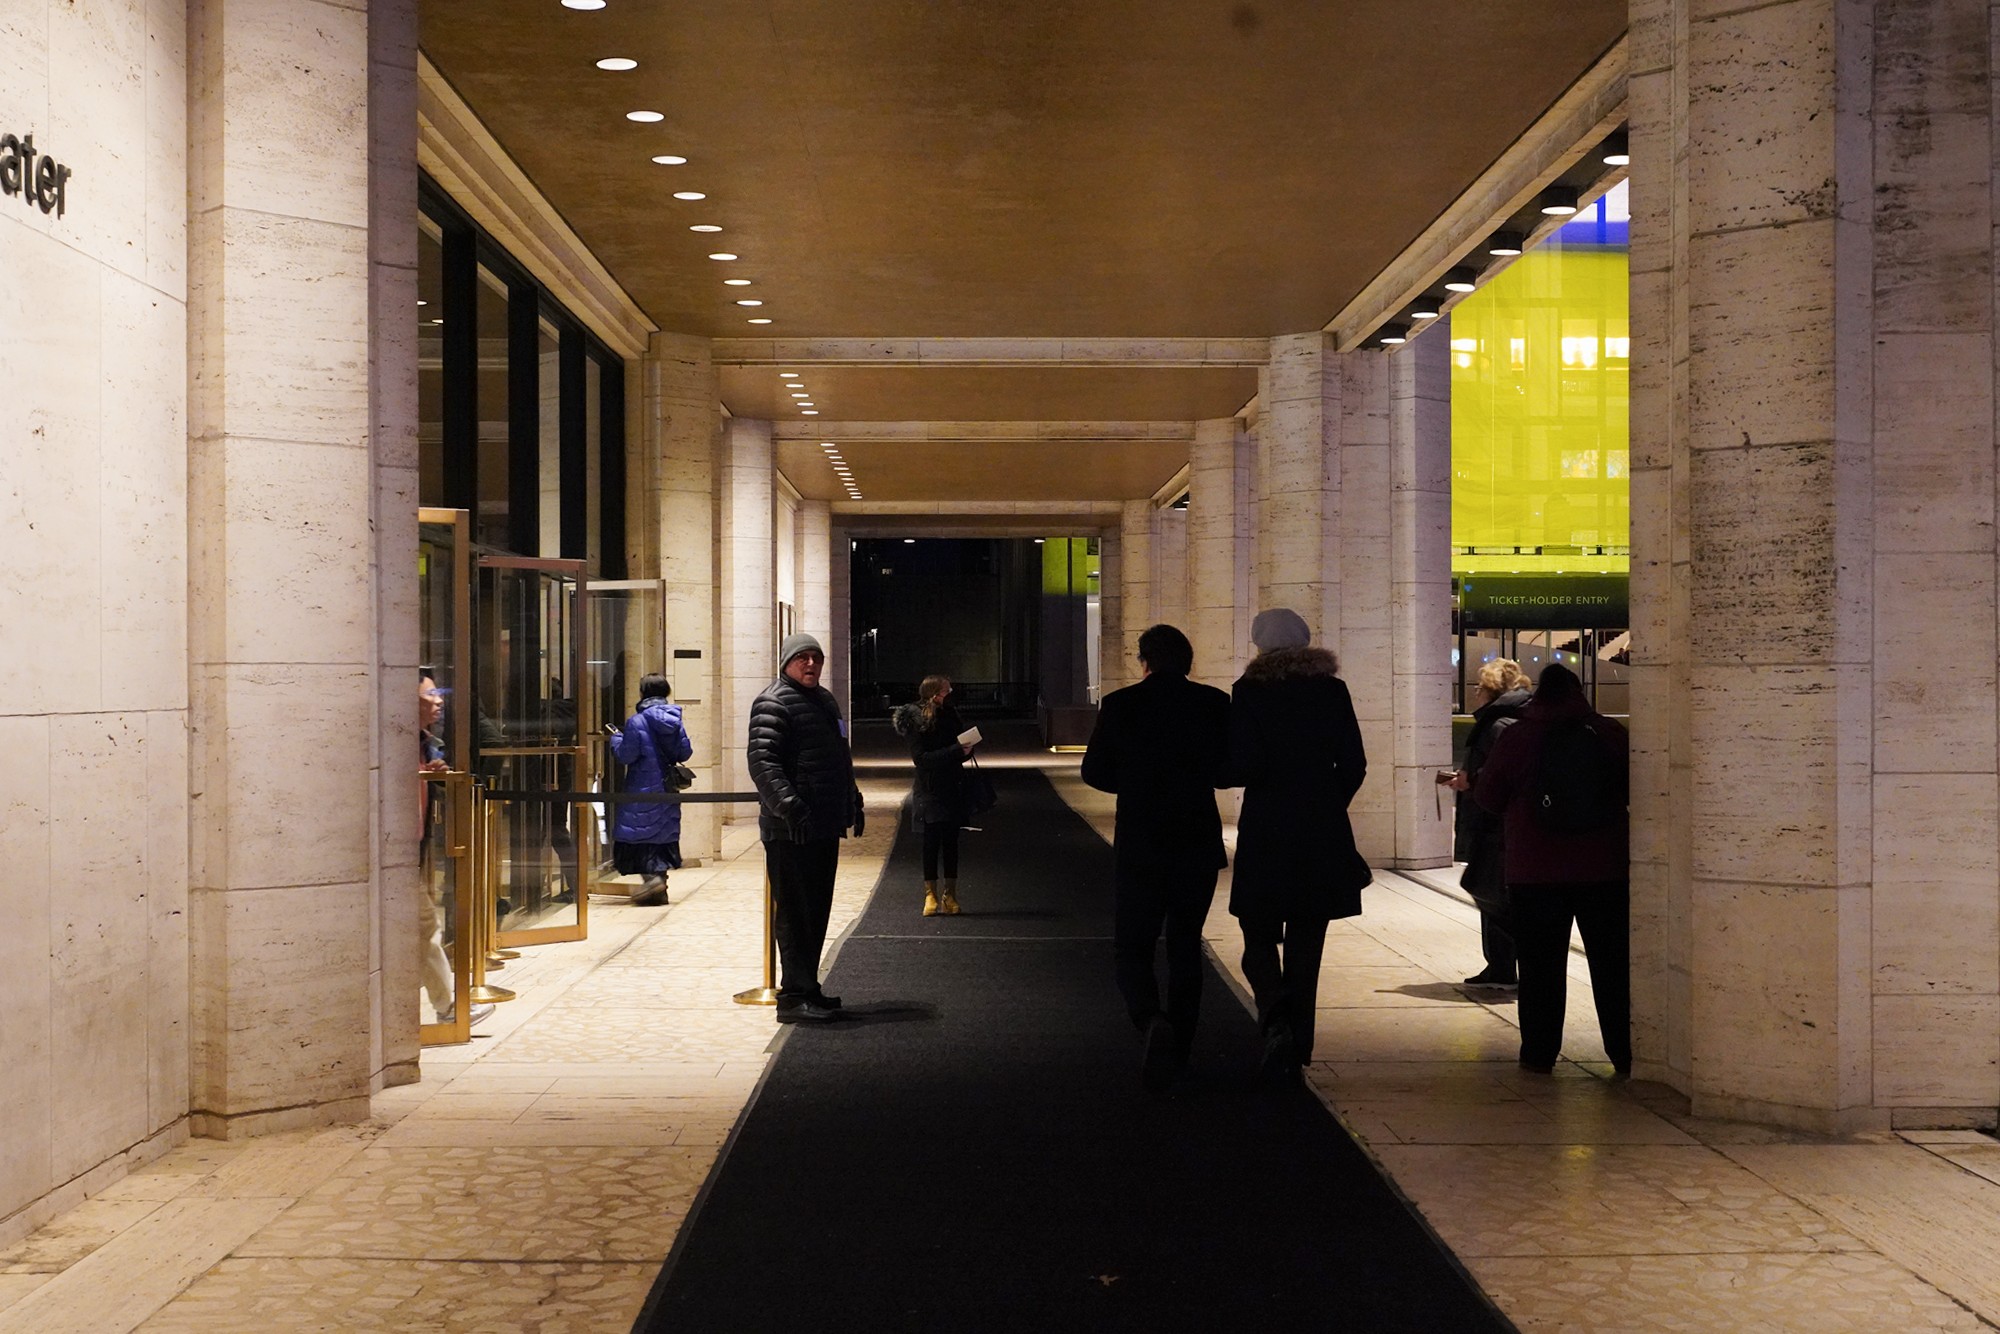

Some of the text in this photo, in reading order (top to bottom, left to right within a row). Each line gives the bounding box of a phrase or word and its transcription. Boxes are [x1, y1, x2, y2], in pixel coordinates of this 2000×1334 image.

[0, 132, 72, 221] ater
[1489, 595, 1610, 605] TICKET-HOLDER ENTRY
